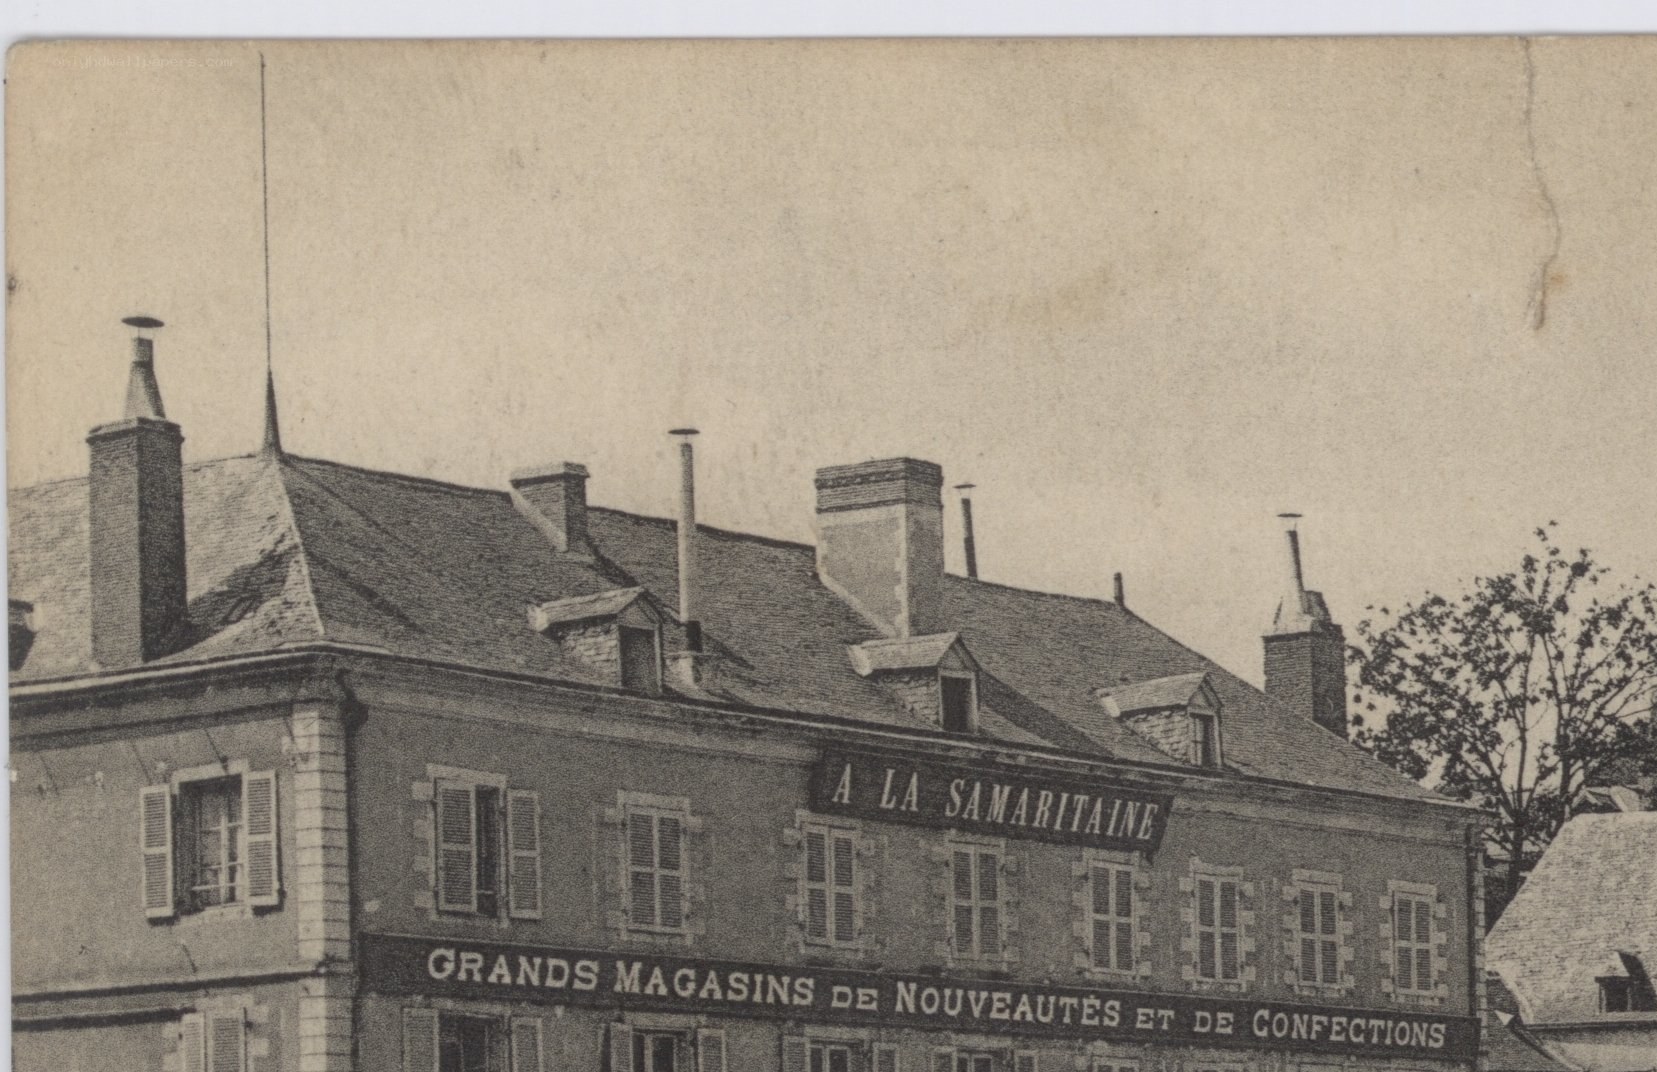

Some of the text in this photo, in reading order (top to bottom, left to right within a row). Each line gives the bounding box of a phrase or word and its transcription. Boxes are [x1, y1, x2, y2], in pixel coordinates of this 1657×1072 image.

[832, 764, 1159, 840] A LA SAMARITAINE
[427, 948, 1447, 1049] GRANDS MAGASINS DE NOUVEAUTÉS ET DE CONFECTIONS
